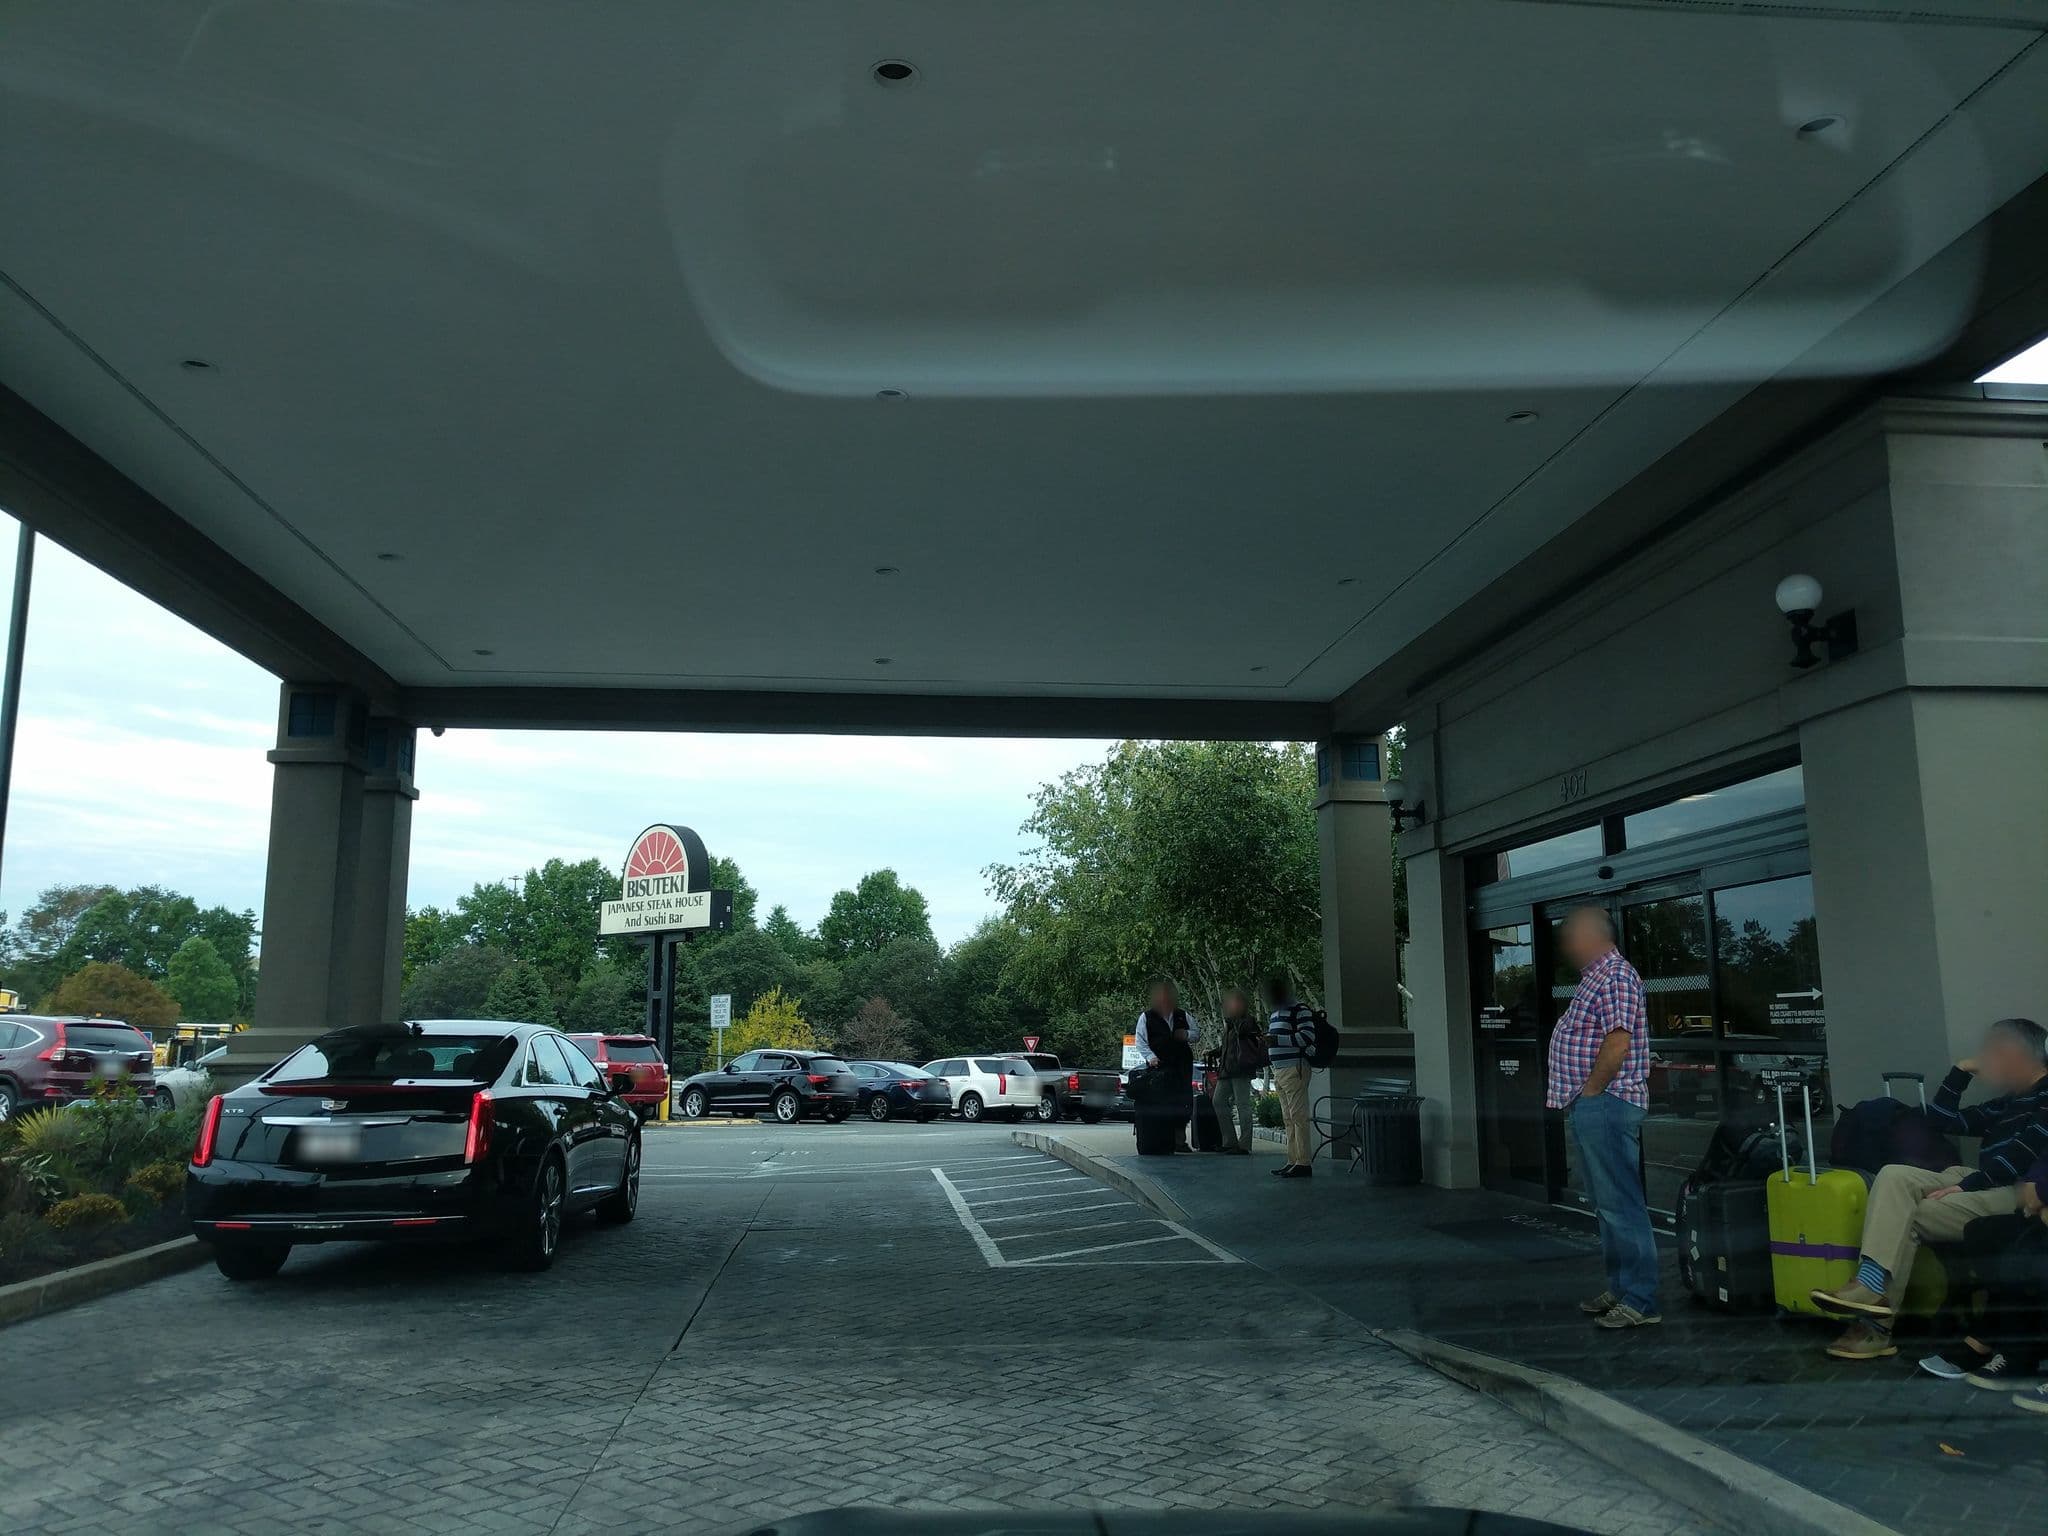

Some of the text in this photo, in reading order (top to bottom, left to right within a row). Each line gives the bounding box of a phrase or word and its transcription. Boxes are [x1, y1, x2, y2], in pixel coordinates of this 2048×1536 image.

[1560, 768, 1588, 803] 407
[627, 875, 685, 898] BISUTEKI
[608, 895, 703, 915] JAPANESE STEAK HOUSE
[624, 912, 684, 927] And Sushi Bar
[1762, 1070, 1771, 1079] ALL
